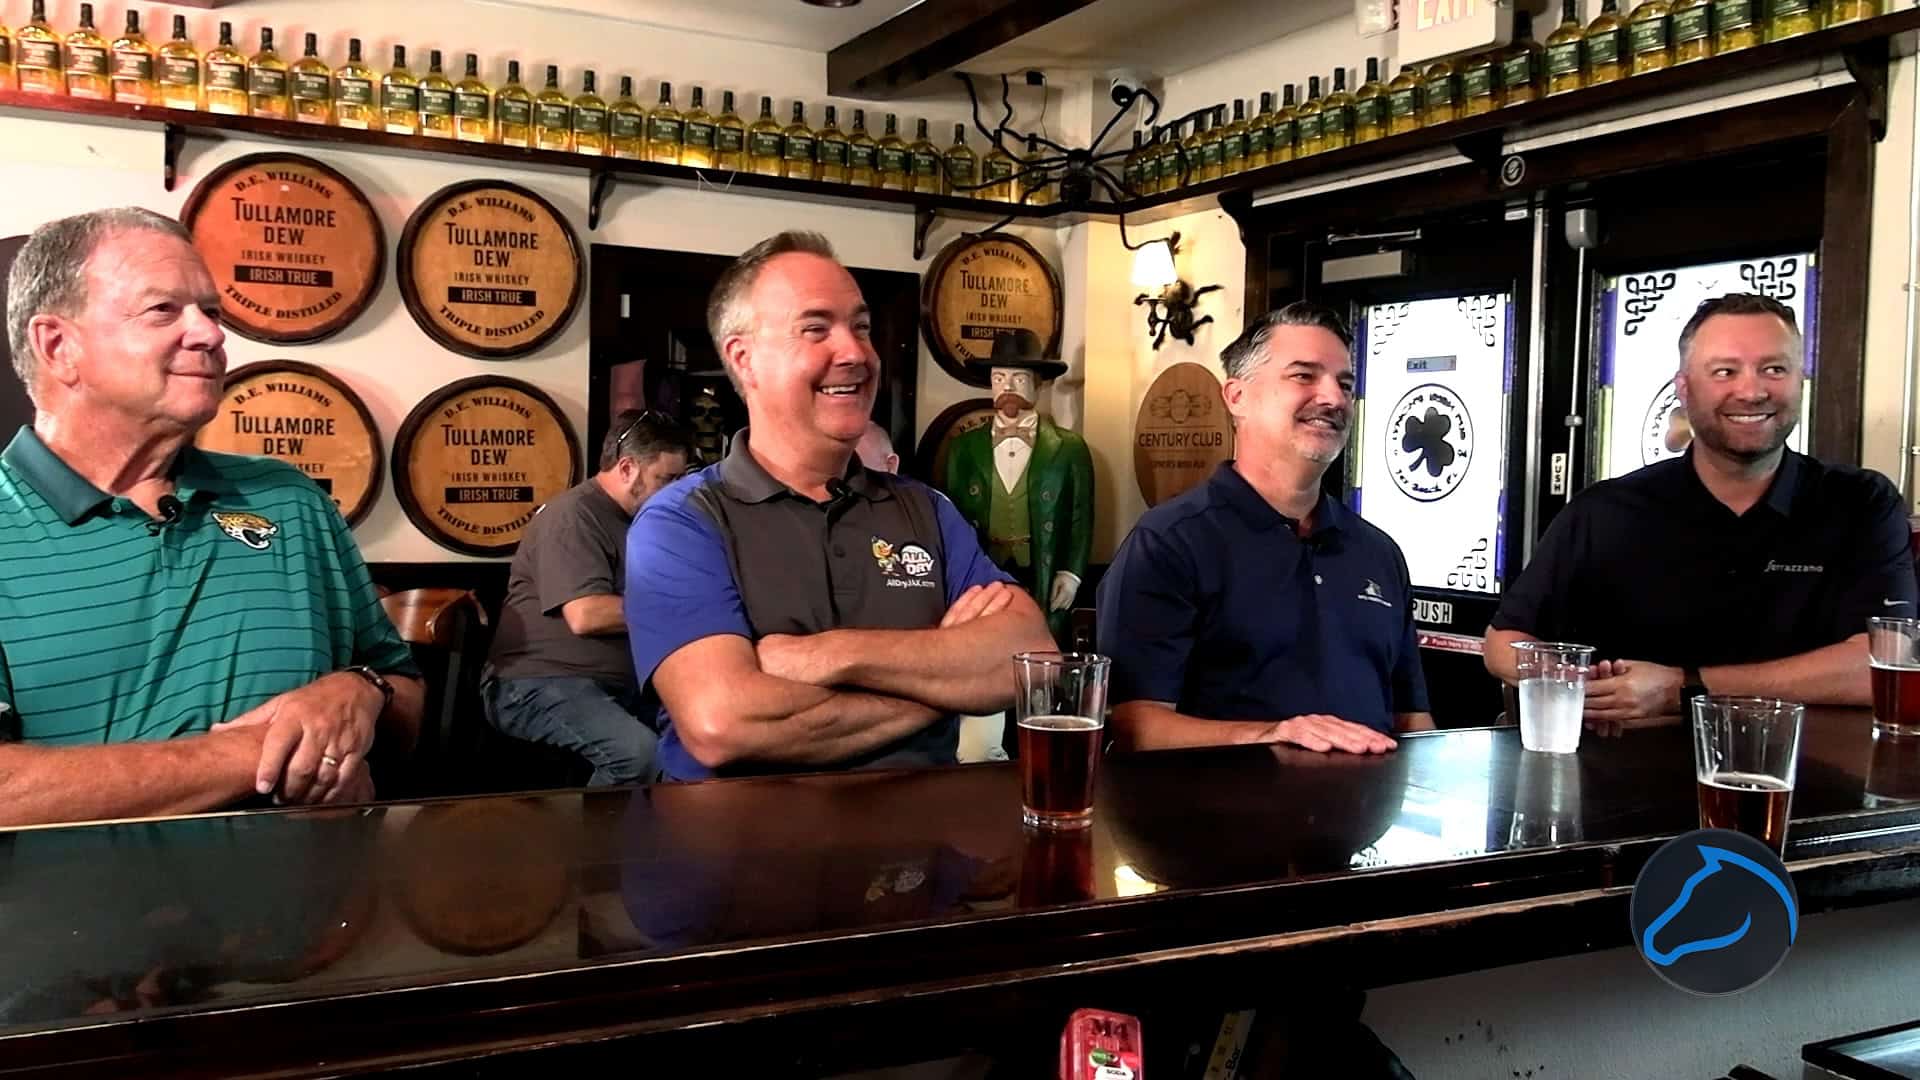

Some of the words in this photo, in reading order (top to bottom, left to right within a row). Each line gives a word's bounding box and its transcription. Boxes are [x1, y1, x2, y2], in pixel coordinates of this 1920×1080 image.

[234, 174, 264, 192] D.E.
[266, 171, 334, 199] WILLIAMS
[447, 201, 472, 218] D.E.
[475, 197, 536, 223] WILLIAMS
[263, 226, 305, 246] DEW
[241, 250, 273, 262] IRISH
[277, 251, 327, 265] WHISKEY
[473, 249, 511, 267] DEW
[983, 248, 1028, 269] WILLIAMS
[249, 267, 284, 282] IRISH
[286, 270, 319, 285] TRUE
[454, 271, 482, 284] IRISH
[485, 272, 530, 286] WHISKEY
[224, 284, 272, 317] TRIPLE
[275, 291, 343, 319] DISTILLED
[461, 288, 492, 302] IRISH
[494, 290, 523, 304] TRUE
[980, 293, 1008, 309] DEW
[439, 304, 482, 336] TRIPLE
[485, 309, 545, 337] DISTILLED
[966, 312, 987, 322] IRISH
[989, 313, 1022, 324] WHISKEY
[971, 327, 994, 338] IRISH
[234, 387, 263, 405] D.E.
[265, 383, 333, 408] WILLIAMS
[444, 401, 471, 419] D.E.
[472, 397, 532, 419] WILLIAMS
[263, 438, 304, 455] DEW
[1138, 432, 1190, 447] CENTURY
[1192, 431, 1222, 447] CLUB
[471, 449, 508, 465] DEW
[297, 463, 326, 474] SKEY
[1554, 455, 1562, 492] PUSH
[451, 472, 479, 483] IRISH
[483, 472, 527, 482] WHISKEY
[458, 488, 490, 501] IRISH
[492, 488, 520, 500] TRUE
[437, 505, 480, 534] TRIPLE
[901, 552, 928, 564] ALL
[906, 560, 934, 575] DRY
[1411, 600, 1451, 623] PUSH
